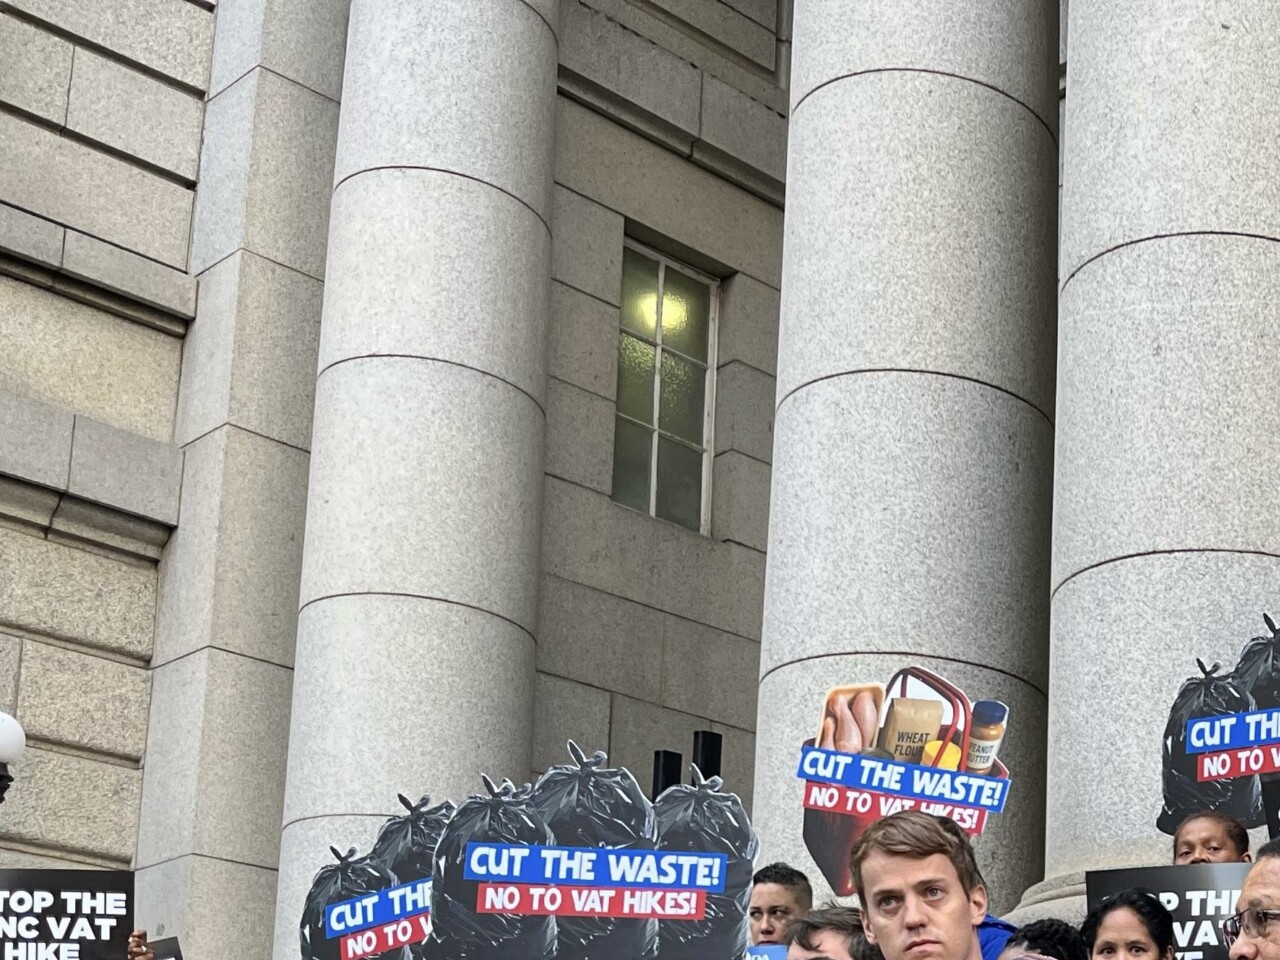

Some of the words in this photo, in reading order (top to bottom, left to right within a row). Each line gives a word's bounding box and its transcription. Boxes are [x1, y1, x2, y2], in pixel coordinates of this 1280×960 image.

[897, 731, 930, 744] WHEAT
[1190, 720, 1236, 747] CUT
[1203, 756, 1231, 777] NO
[1237, 751, 1264, 772] TO
[802, 752, 851, 779] CUT
[860, 760, 902, 790] THE
[913, 769, 1004, 806] WASTE!
[809, 787, 839, 807] NO
[846, 791, 872, 812] TO
[470, 846, 529, 878] CUT
[541, 849, 596, 881] THE
[610, 854, 721, 886] WASTE!
[0, 891, 54, 913] TOP
[61, 892, 127, 915] THE
[330, 895, 379, 931] CUT
[485, 887, 520, 910] NO
[529, 888, 562, 911] TO
[572, 890, 615, 912] VAT
[624, 891, 697, 914] HIKES!
[0, 916, 39, 939] NC
[46, 917, 117, 940] VAT
[347, 931, 377, 958] NO
[384, 921, 412, 946] TO
[1173, 920, 1224, 947] VA
